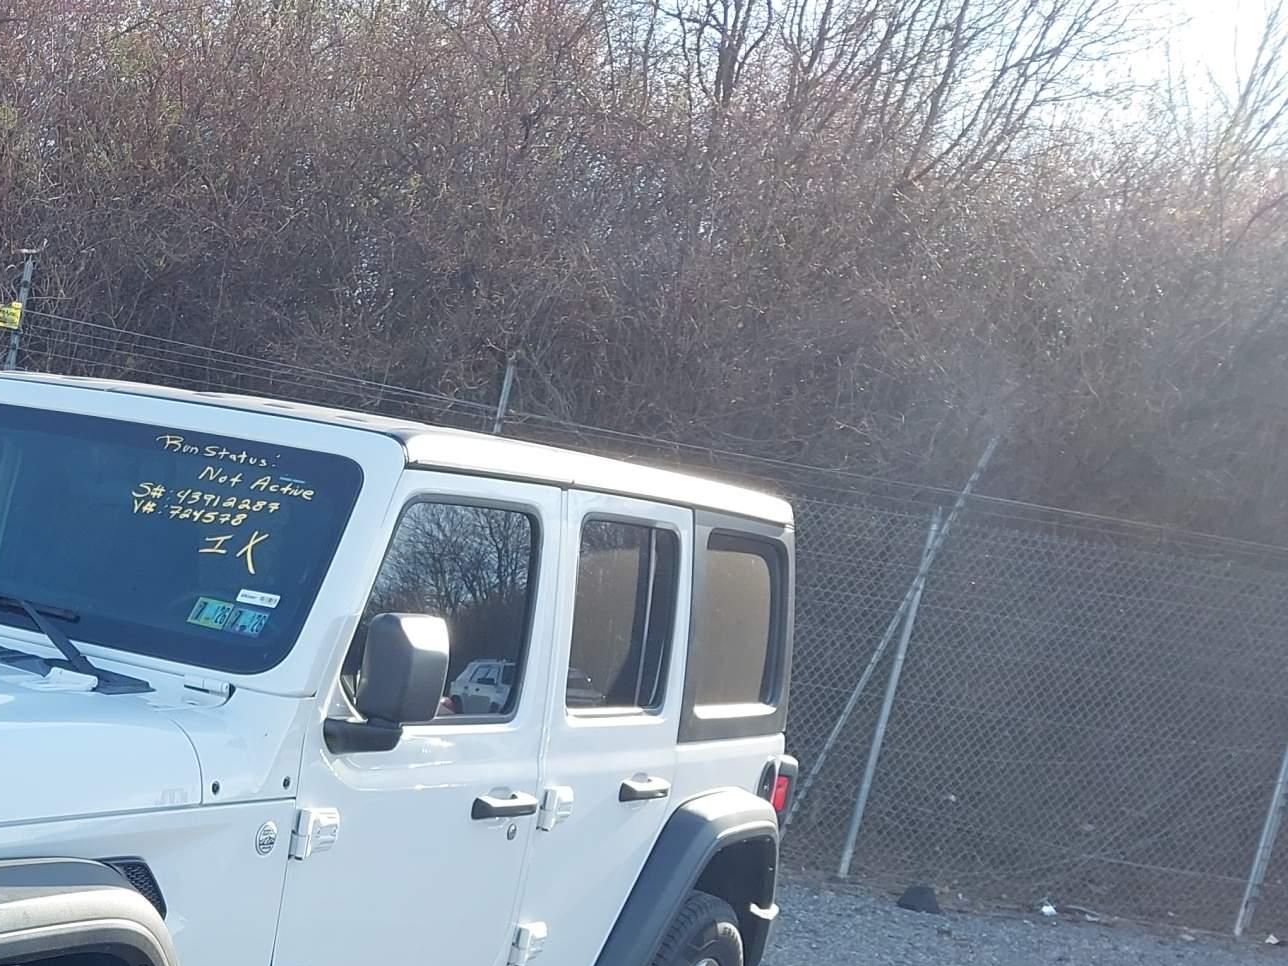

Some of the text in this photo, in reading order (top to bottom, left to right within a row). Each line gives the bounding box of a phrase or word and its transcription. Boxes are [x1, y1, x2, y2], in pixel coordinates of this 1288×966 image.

[156, 434, 199, 453] Run
[198, 466, 315, 501] Not Active
[176, 489, 281, 513] 43912287
[169, 505, 248, 527] 724578
